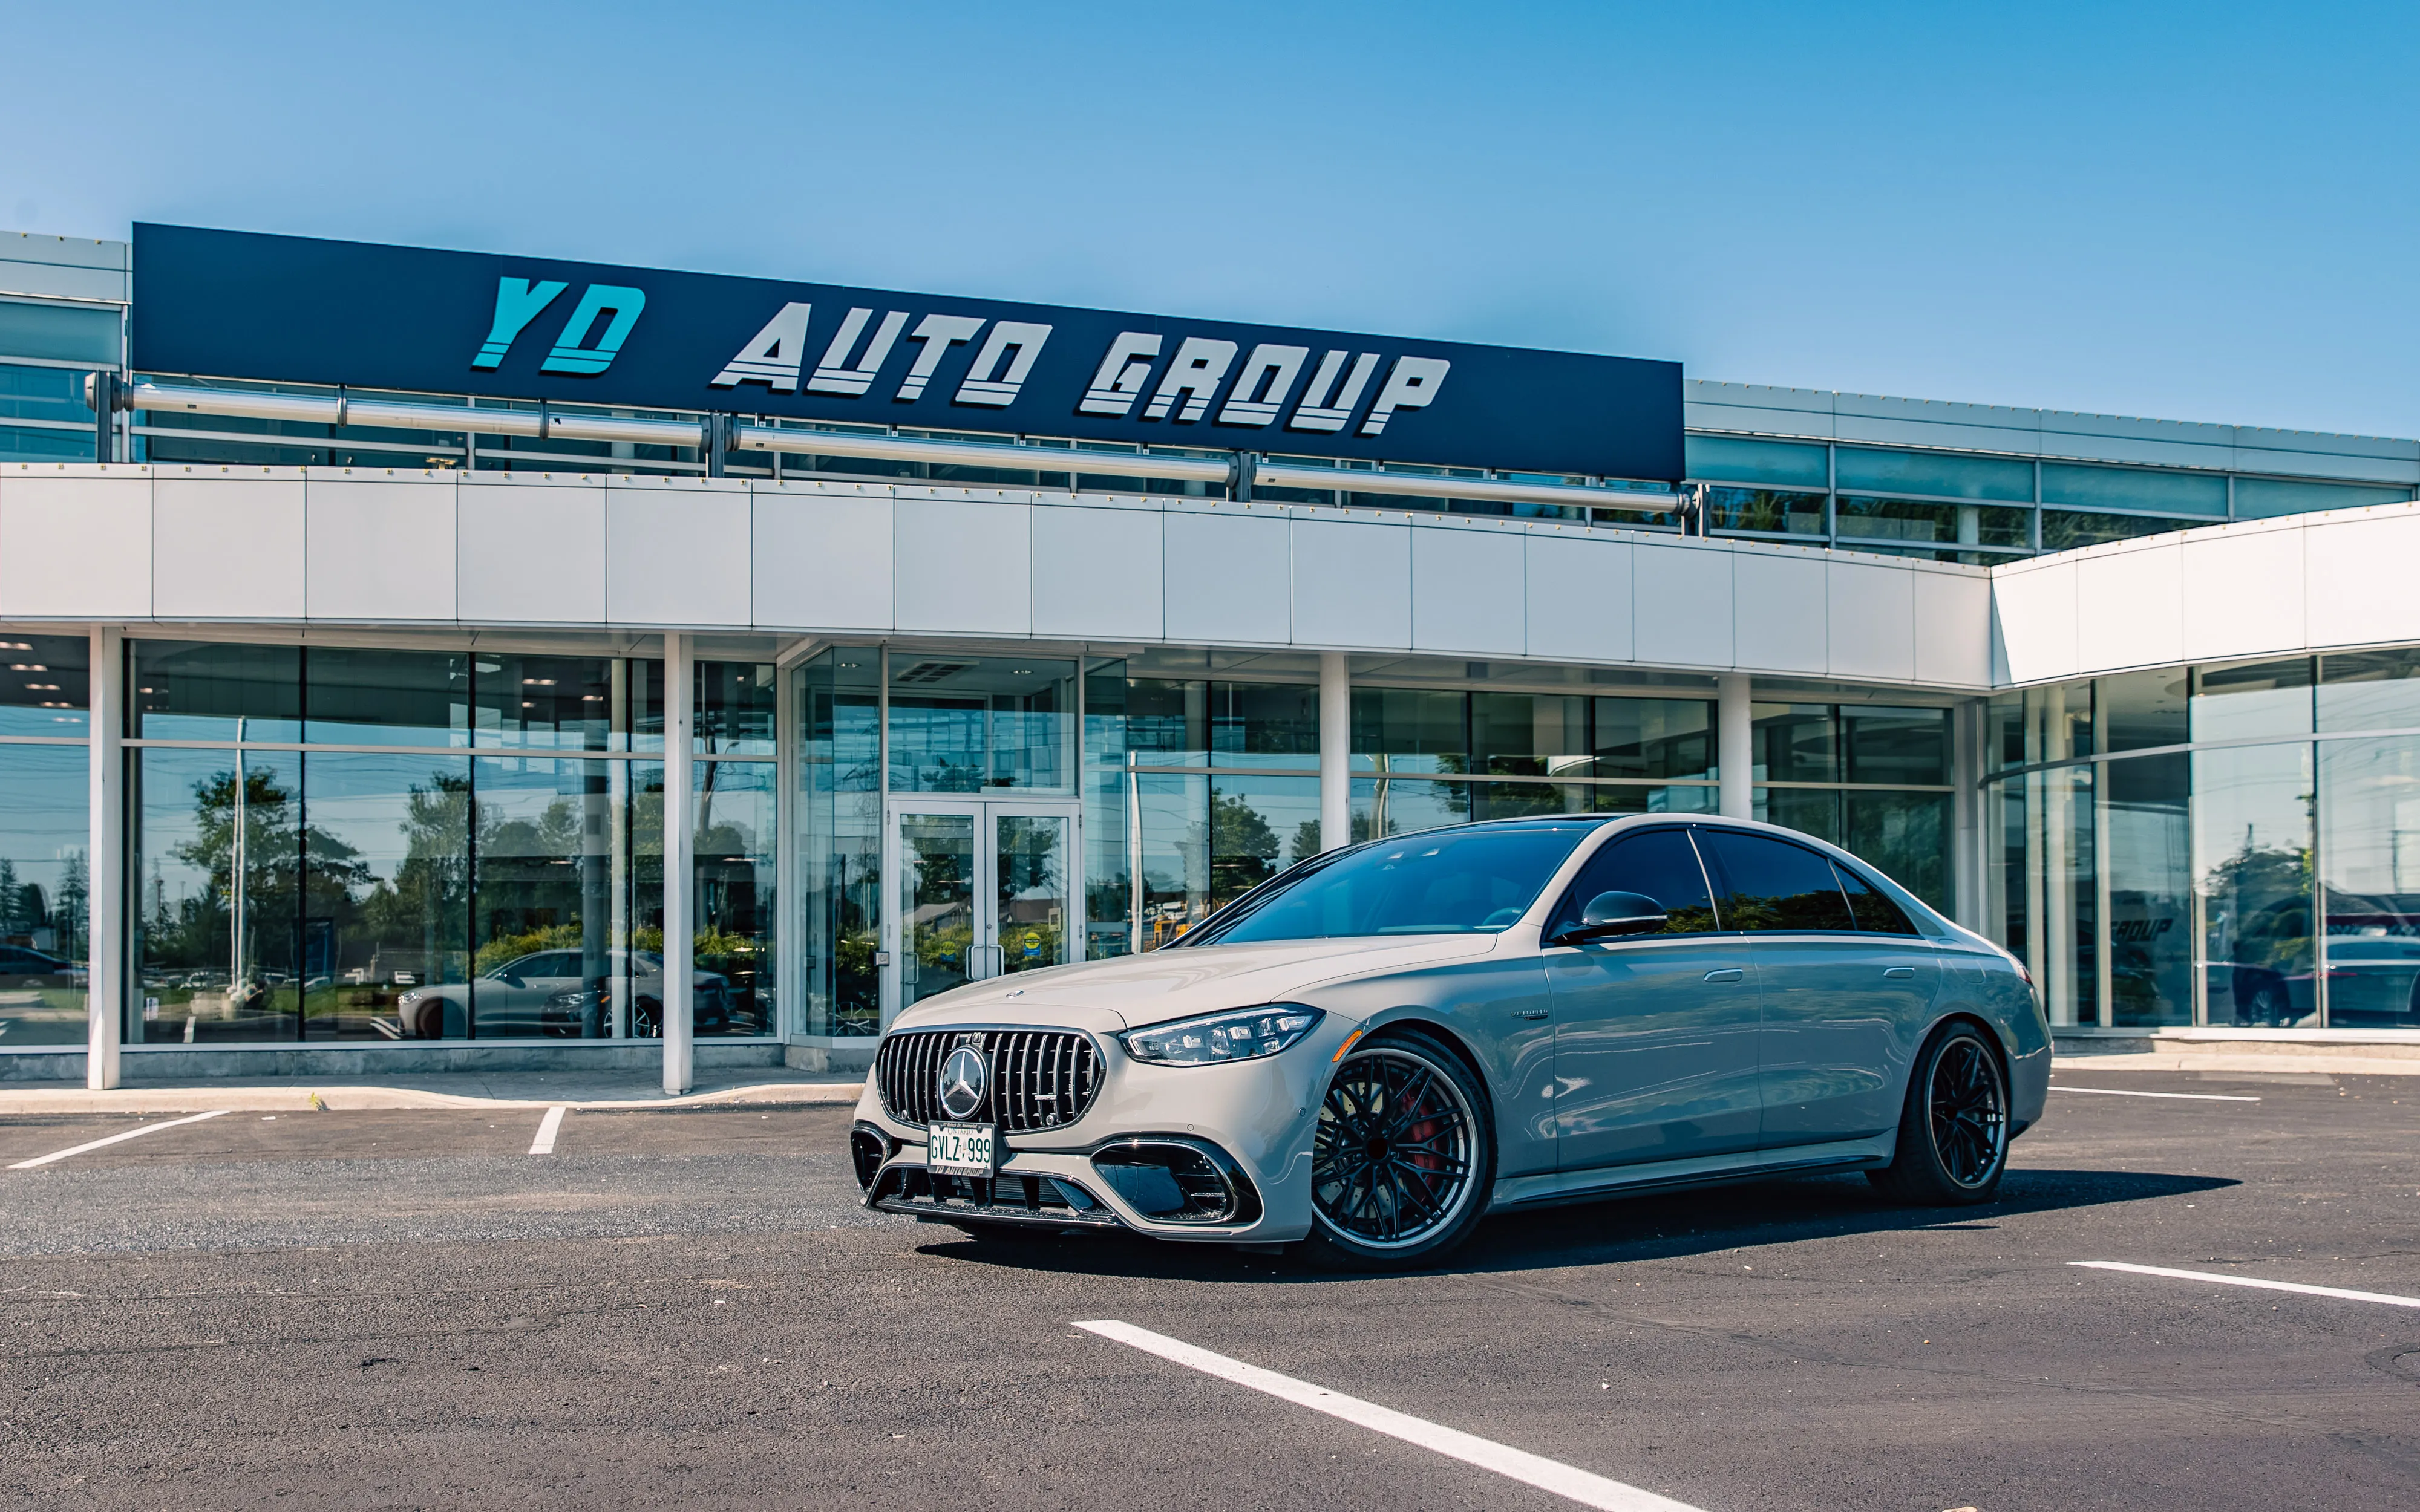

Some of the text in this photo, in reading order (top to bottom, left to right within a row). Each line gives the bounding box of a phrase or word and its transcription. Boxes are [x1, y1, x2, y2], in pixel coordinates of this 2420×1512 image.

[472, 276, 1450, 434] YD AUTO GROUP
[932, 1135, 990, 1163] GVLZ 999
[945, 1166, 963, 1175] AUTO
[962, 1168, 984, 1176] GROUP
